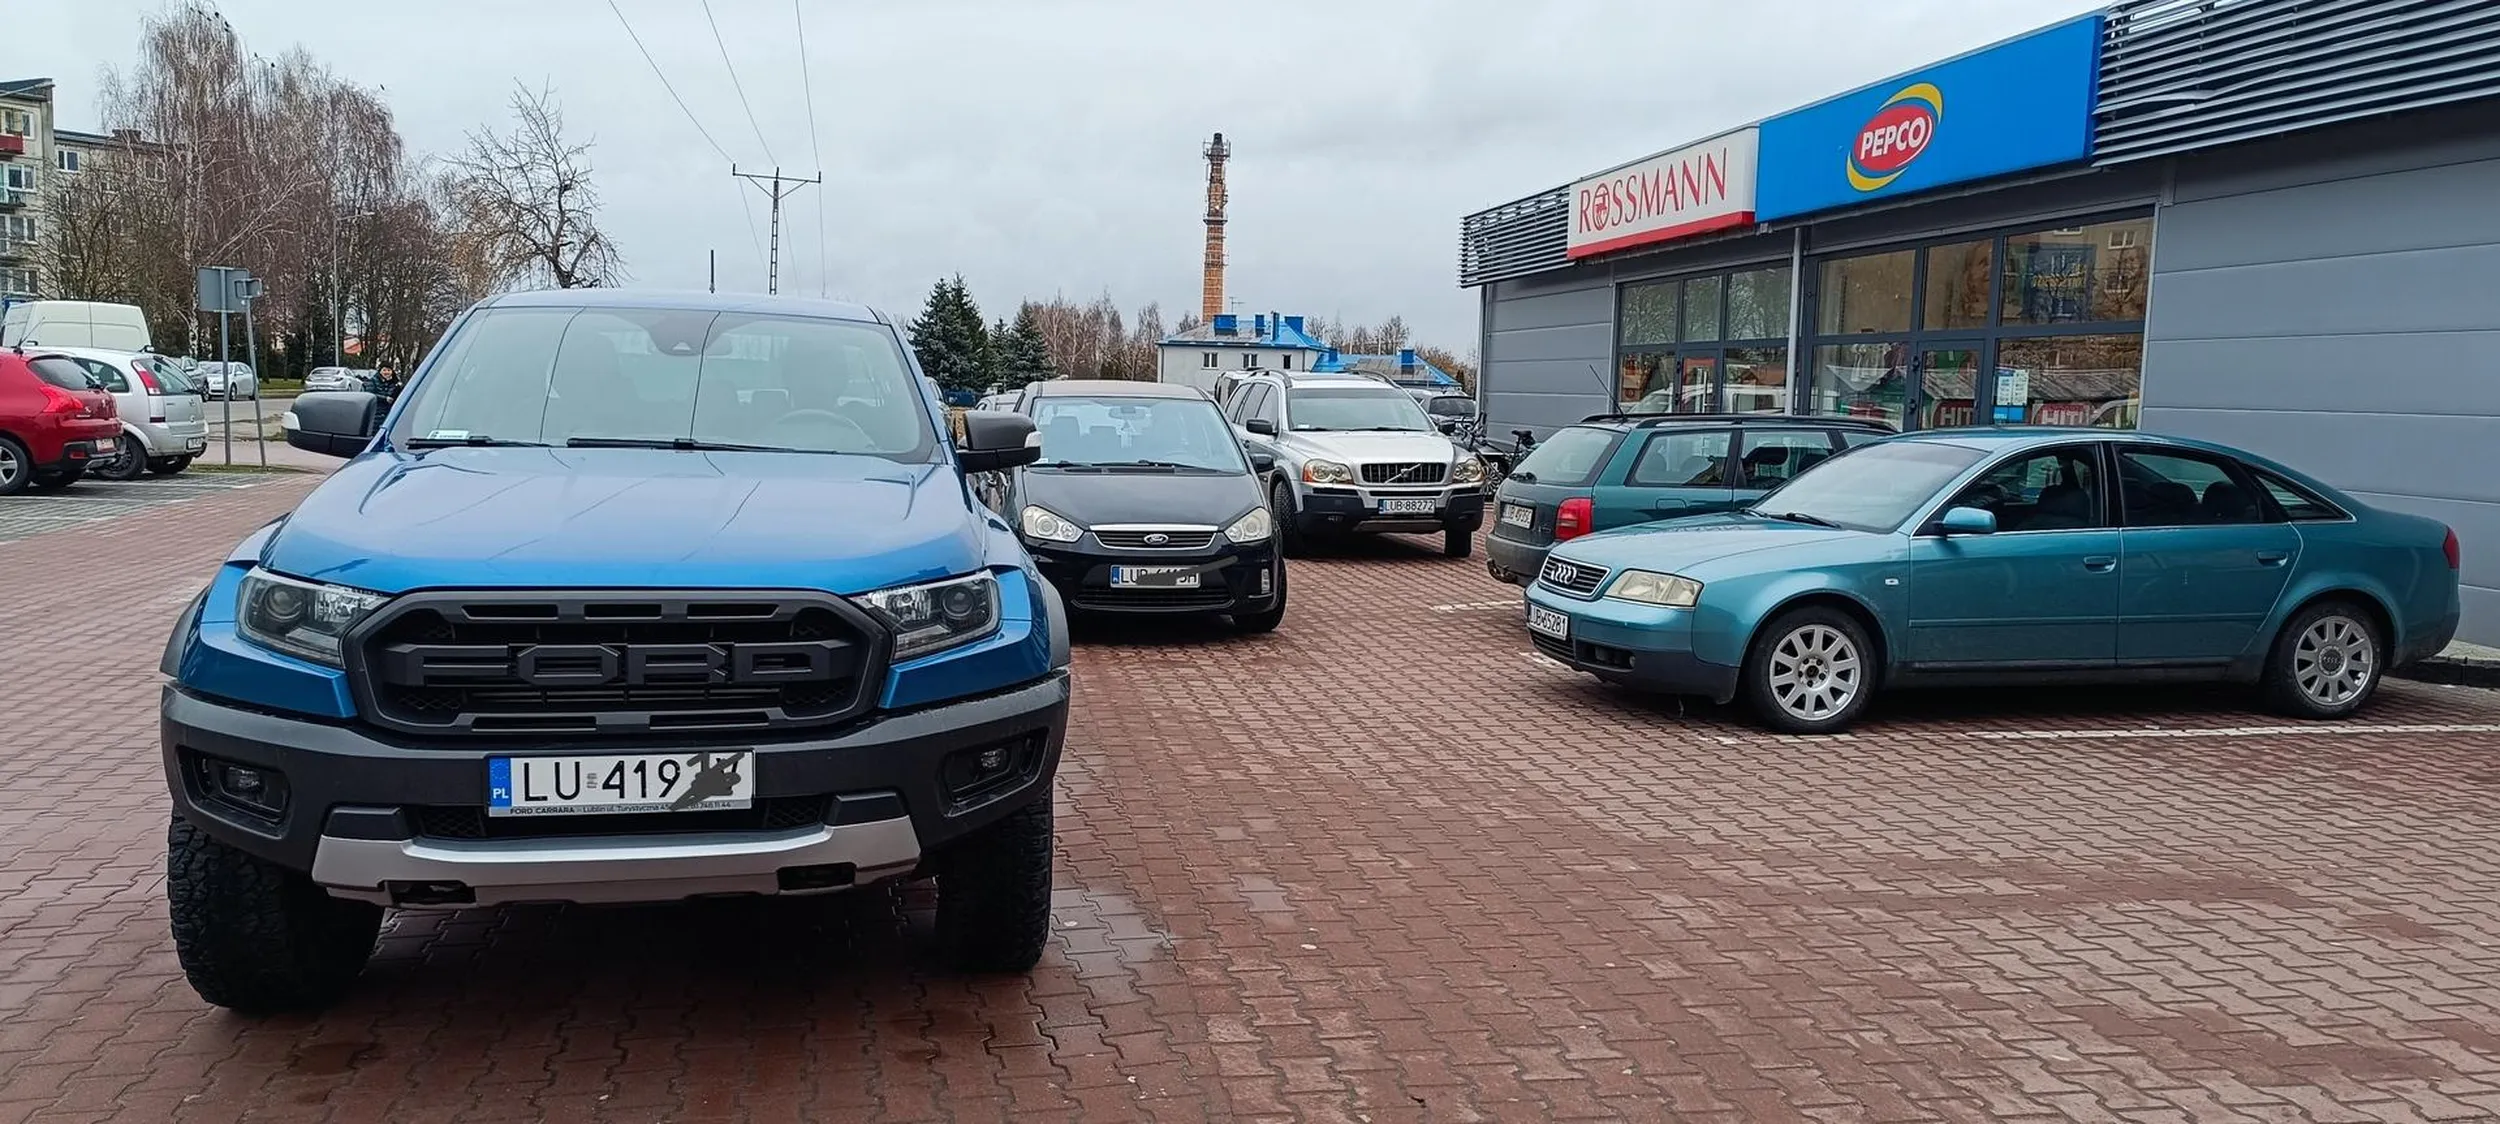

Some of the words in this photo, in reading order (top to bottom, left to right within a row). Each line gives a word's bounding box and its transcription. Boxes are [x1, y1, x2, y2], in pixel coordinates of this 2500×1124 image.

[1860, 116, 1926, 160] PEPCO
[1578, 147, 1727, 234] ROSSMANN
[386, 641, 851, 687] FORD
[492, 788, 509, 799] PL
[523, 760, 581, 802] LU
[509, 807, 533, 815] FORD
[535, 806, 575, 814] CARRARA
